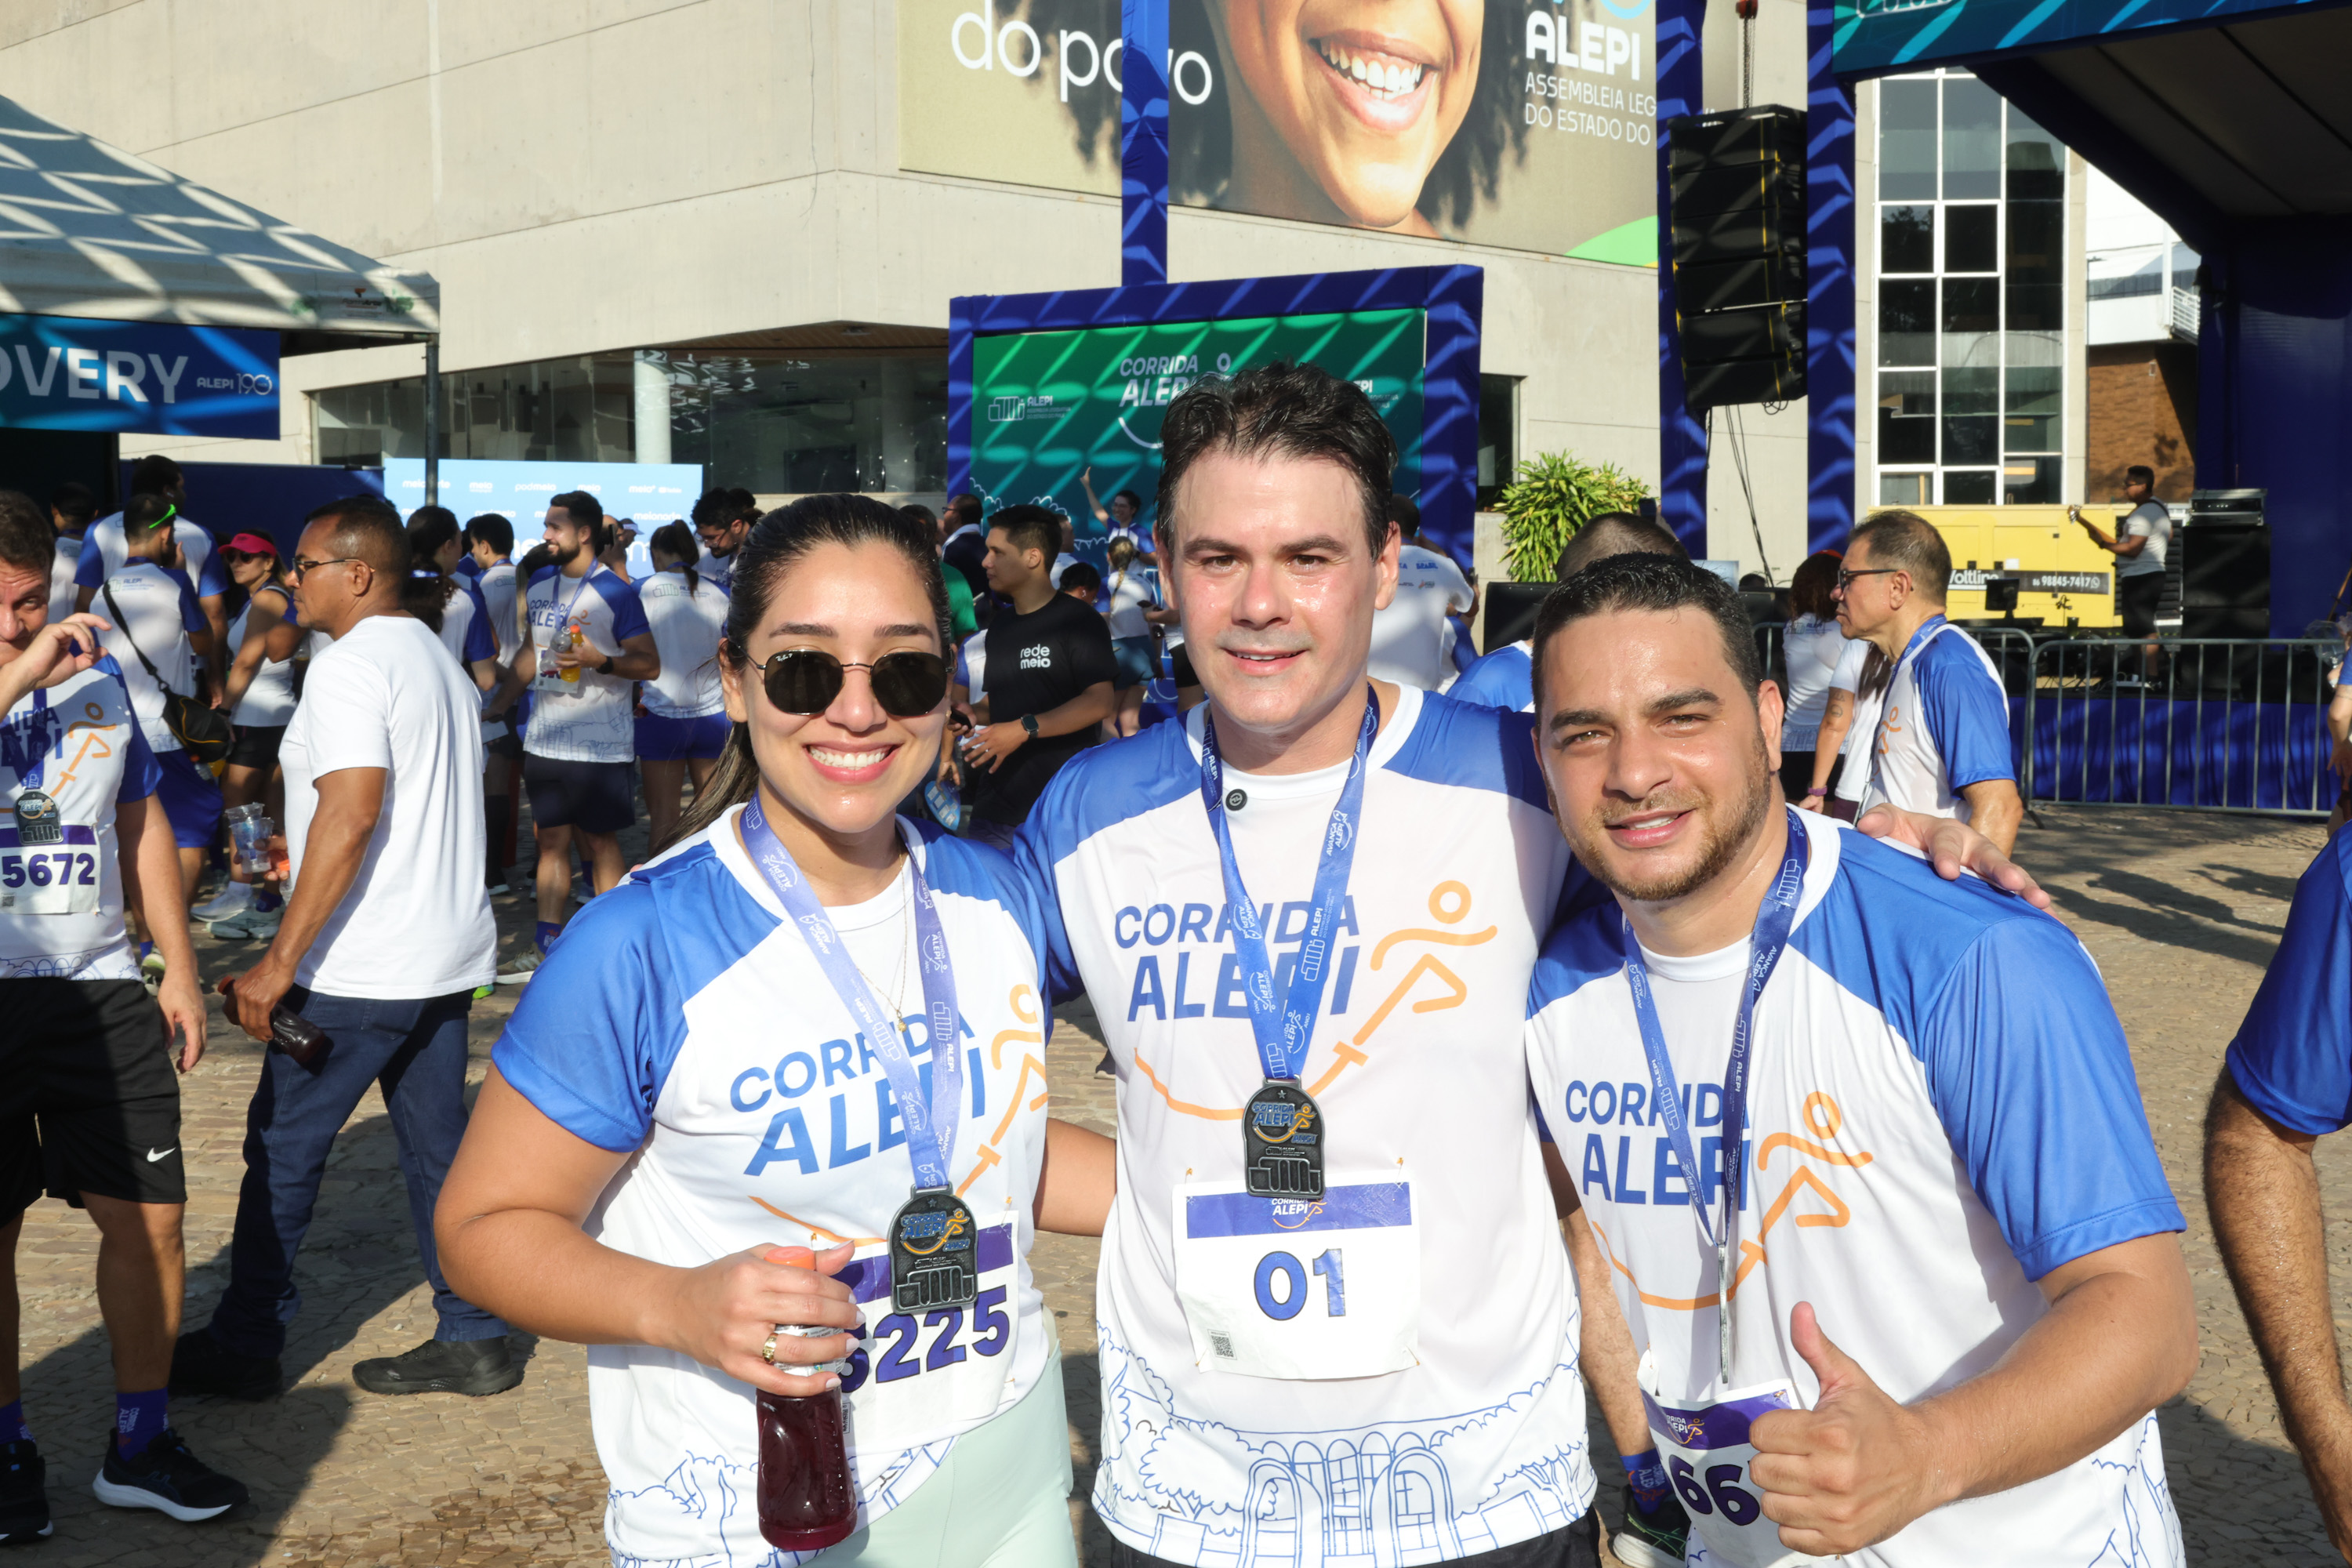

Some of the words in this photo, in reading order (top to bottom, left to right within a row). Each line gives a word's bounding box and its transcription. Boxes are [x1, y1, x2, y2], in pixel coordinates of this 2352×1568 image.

[951, 0, 1041, 77] do
[1060, 29, 1212, 105] poo
[1526, 10, 1640, 81] ALEPI
[1525, 71, 1624, 114] ASSEMBLEIA
[1629, 92, 1657, 117] LEG
[1525, 103, 1552, 127] DO
[1557, 109, 1622, 140] ESTADO
[1627, 122, 1650, 145] DO
[0, 344, 188, 404] VERY
[1120, 354, 1198, 376] CORRIDA
[197, 377, 234, 389] ALEPI
[1119, 376, 1193, 408] ALEP
[1027, 395, 1053, 407] ALEPI
[2042, 575, 2090, 587] 98845-7417
[1020, 644, 1050, 658] rede
[1020, 657, 1051, 670] meio
[1208, 755, 1218, 780] ALEPI
[1326, 822, 1338, 857] AVANÇA
[1335, 823, 1344, 848] ALEPI
[2, 853, 96, 888] 5672
[768, 866, 786, 891] CORRIDA
[772, 865, 793, 887] ALEPI
[1239, 906, 1248, 929] ALEPI
[1311, 907, 1323, 936] ALEPI
[815, 922, 831, 943] ALEPI
[931, 934, 941, 960] ALEPI
[1758, 946, 1777, 978] AVANÇA
[1256, 971, 1269, 999] ALEPI
[1263, 971, 1273, 999] CORRIDA
[855, 997, 873, 1023] ALEPI
[1652, 1059, 1663, 1087] ALEPI
[909, 1103, 922, 1131] ALEPI
[1253, 1104, 1294, 1112] CORRIDA
[1254, 1112, 1294, 1126] ALEPI
[902, 1212, 946, 1225] CORRIDA
[1272, 1203, 1308, 1216] ALEPI
[903, 1222, 946, 1239] ALEPI
[1254, 1248, 1346, 1321] 01
[1666, 1415, 1686, 1425] RRIDA
[1672, 1422, 1689, 1434] EPI
[1668, 1454, 1760, 1526] 66
